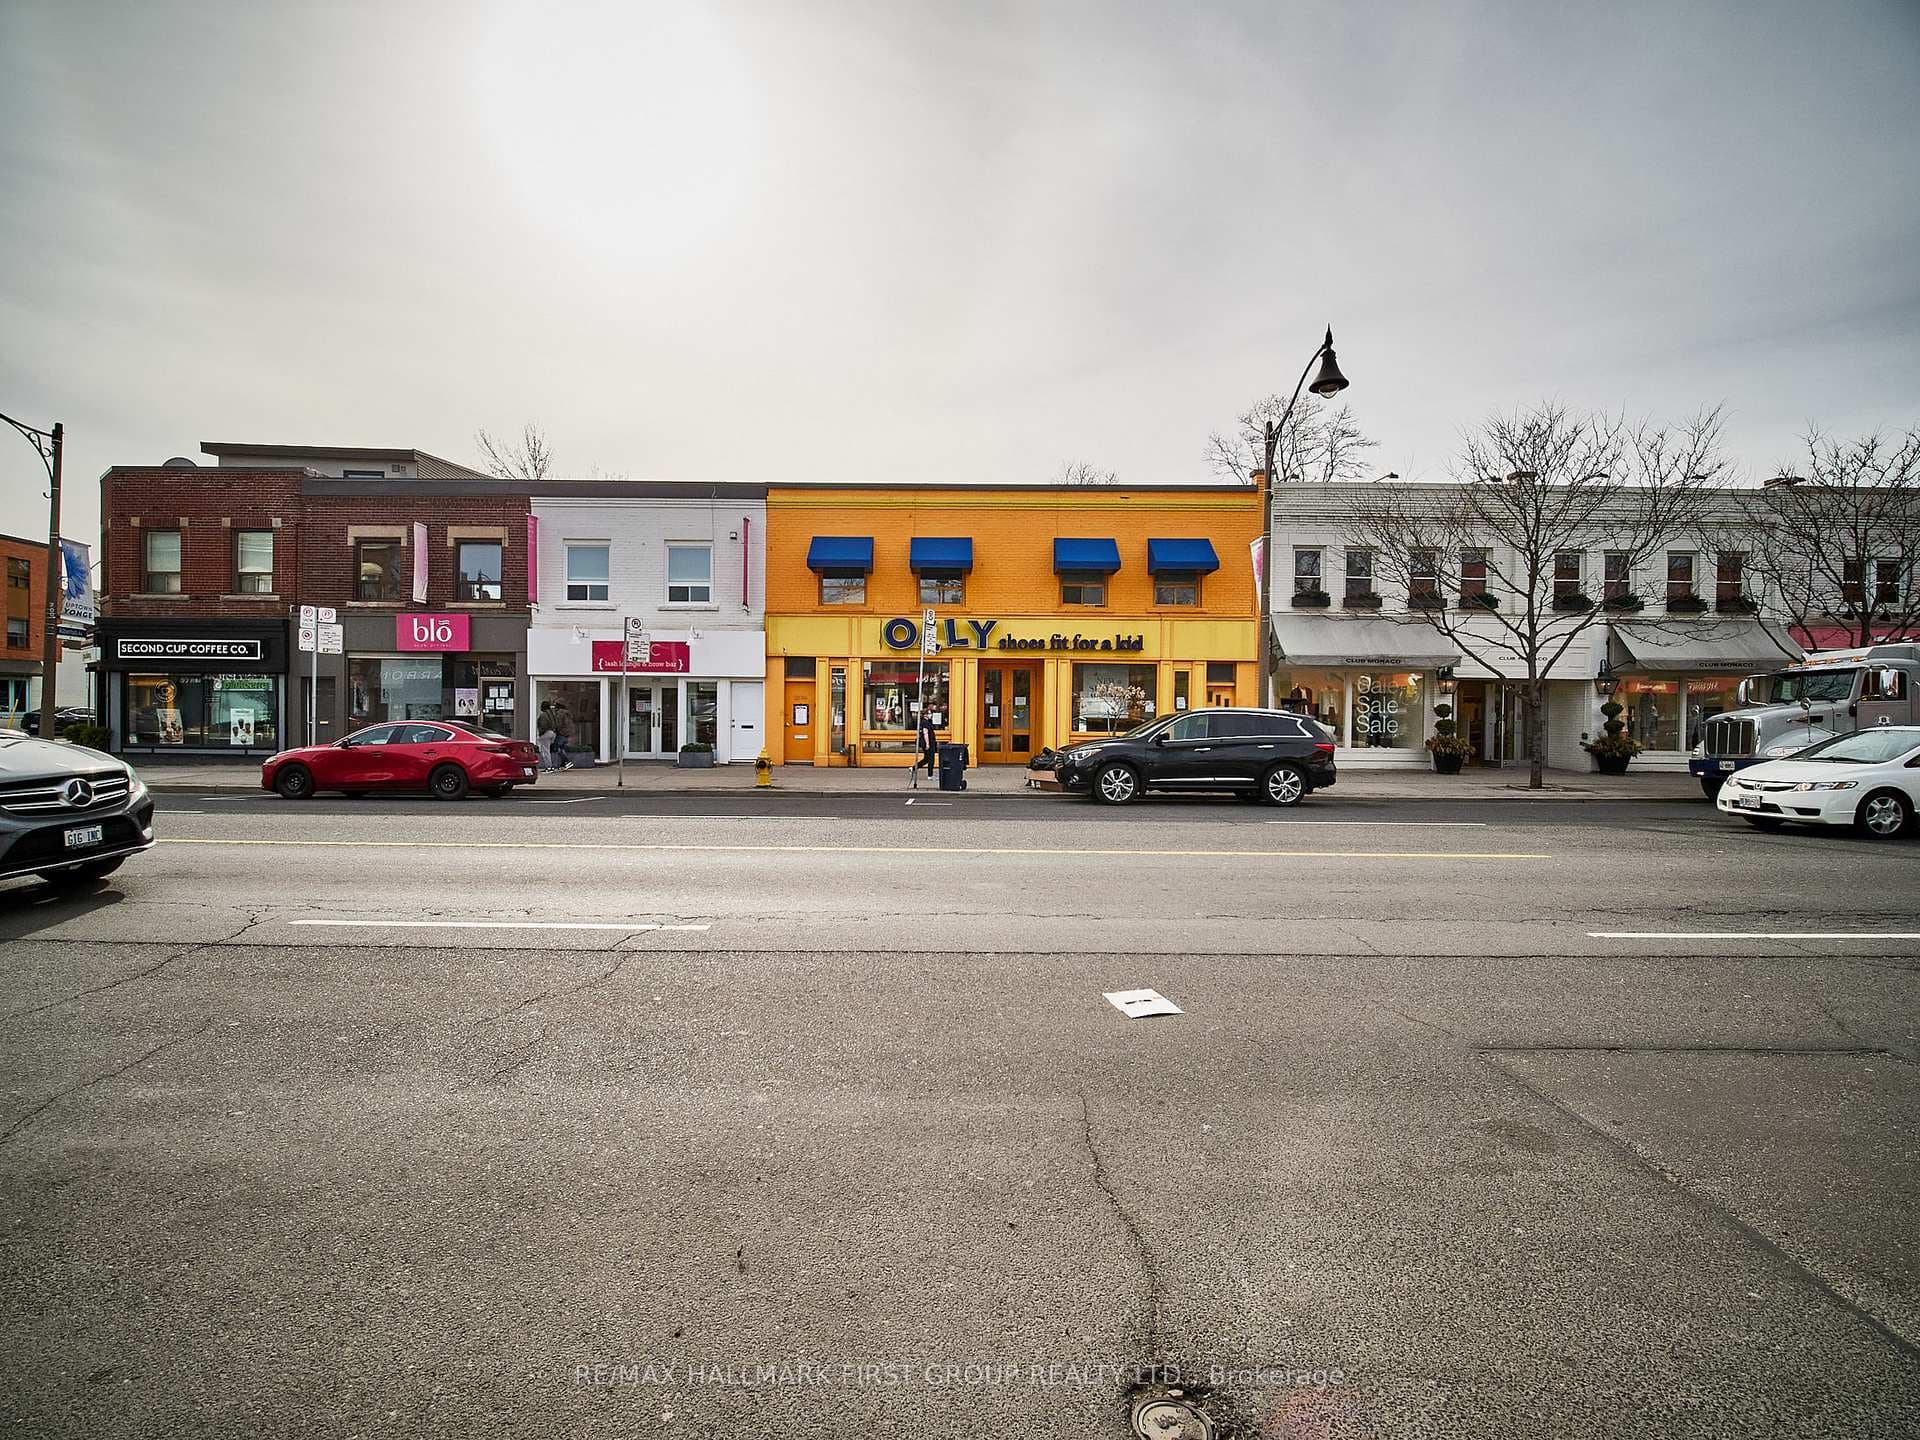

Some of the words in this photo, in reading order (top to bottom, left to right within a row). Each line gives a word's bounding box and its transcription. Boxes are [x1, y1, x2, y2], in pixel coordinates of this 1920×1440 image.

[64, 608, 93, 619] YONGE
[121, 644, 165, 653] SECOND
[166, 645, 188, 653] CUP
[190, 645, 229, 654] COFFEE
[230, 645, 249, 654] CO.
[998, 634, 1045, 650] shoes
[1049, 634, 1069, 650] fit
[1072, 634, 1098, 650] for
[1100, 639, 1113, 650] a
[1115, 634, 1144, 651] kid
[1357, 675, 1399, 695] Sale
[1356, 695, 1399, 714] Sale
[1356, 715, 1399, 734] Sale
